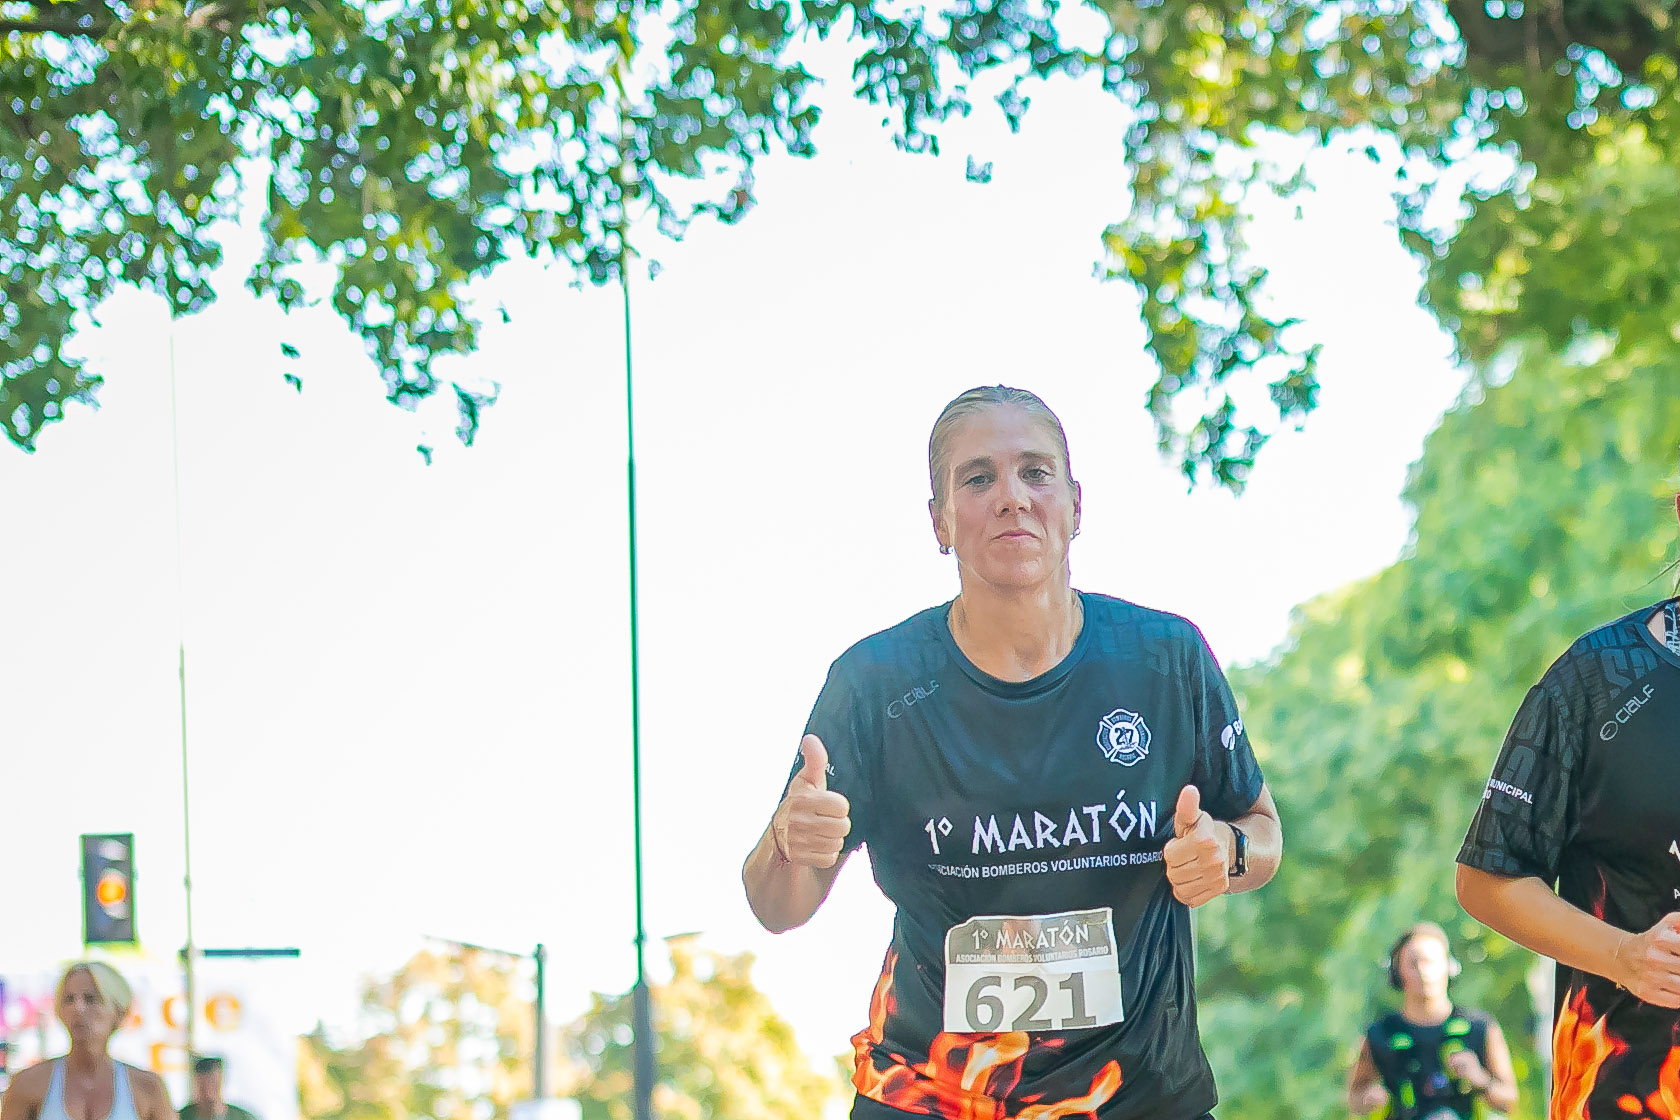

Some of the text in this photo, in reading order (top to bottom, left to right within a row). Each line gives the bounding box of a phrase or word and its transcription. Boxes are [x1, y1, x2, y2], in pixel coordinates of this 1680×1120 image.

[971, 789, 1157, 855] MARATÓN
[981, 861, 1048, 879] BOMBEROS
[1050, 854, 1128, 873] VOLUNTARIOS
[995, 920, 1089, 950] MARATÓN
[1078, 945, 1109, 958] ROSARIO
[965, 972, 1097, 1032] 621
